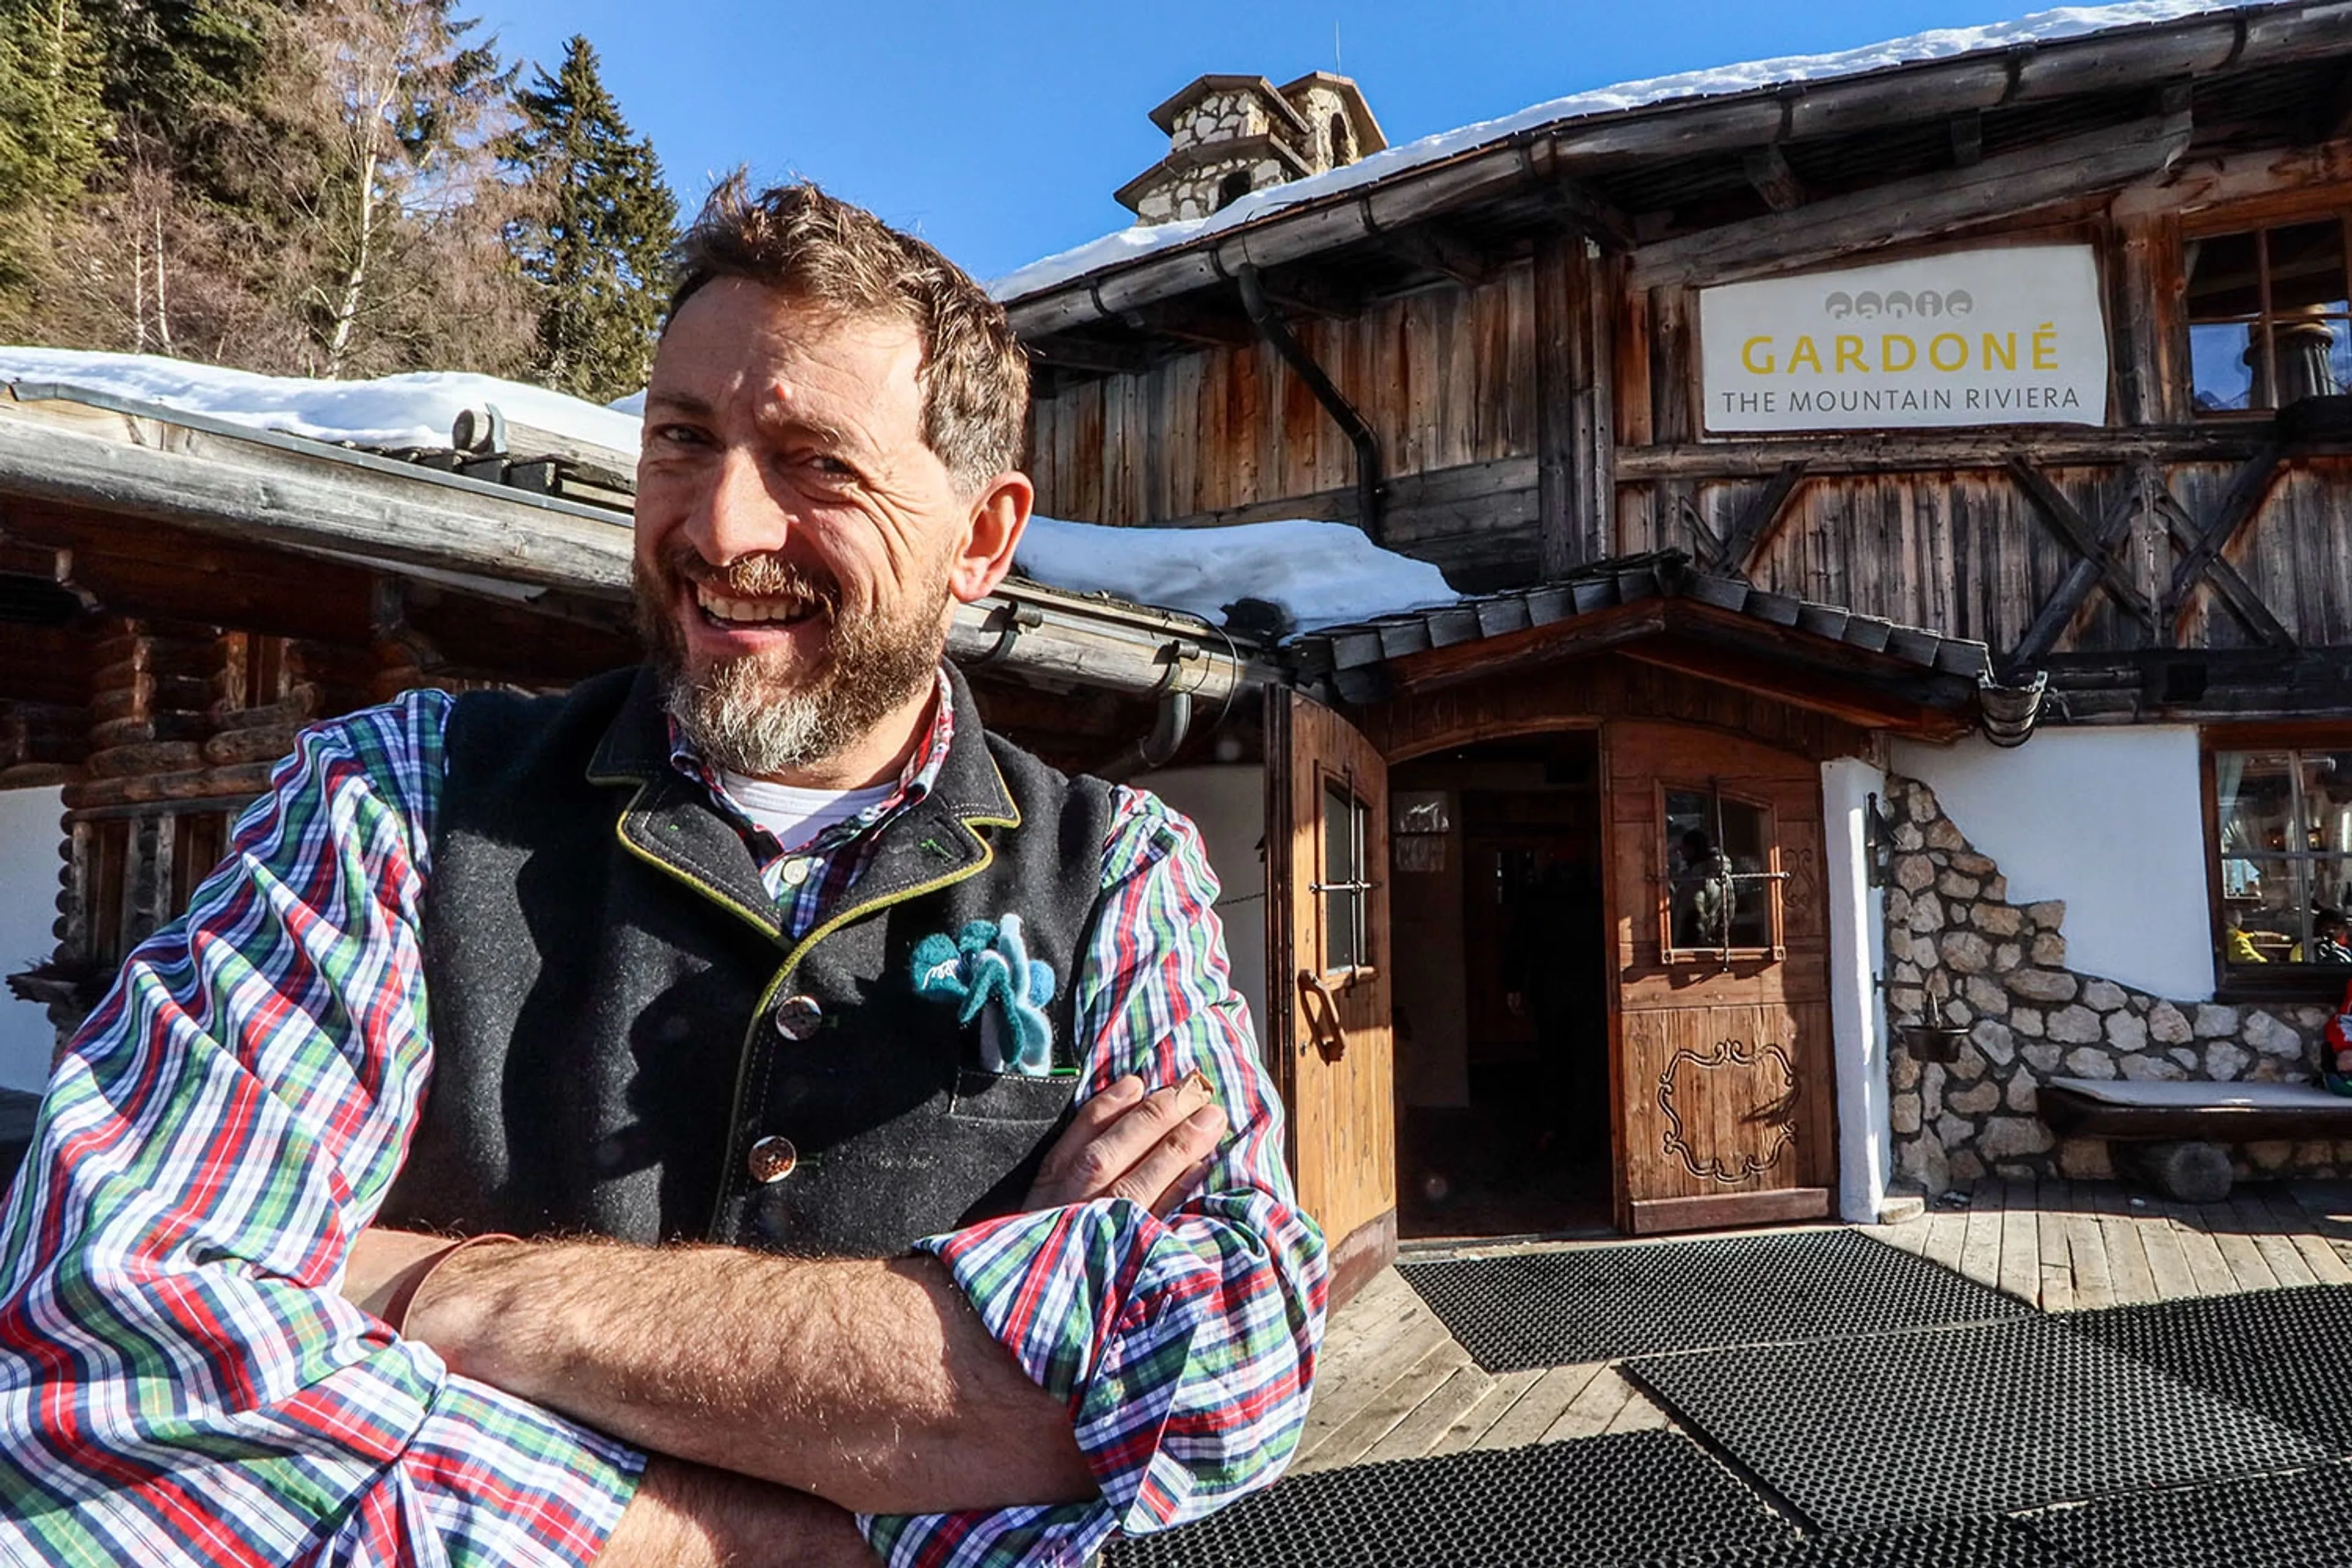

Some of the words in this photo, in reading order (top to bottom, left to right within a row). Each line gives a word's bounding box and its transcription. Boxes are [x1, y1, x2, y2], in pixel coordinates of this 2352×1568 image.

[1740, 321, 2059, 375] GARDONÉ
[1721, 391, 1776, 414] THE
[1789, 388, 1951, 413] MOUNTAIN
[1965, 386, 2080, 410] RIVIERA
